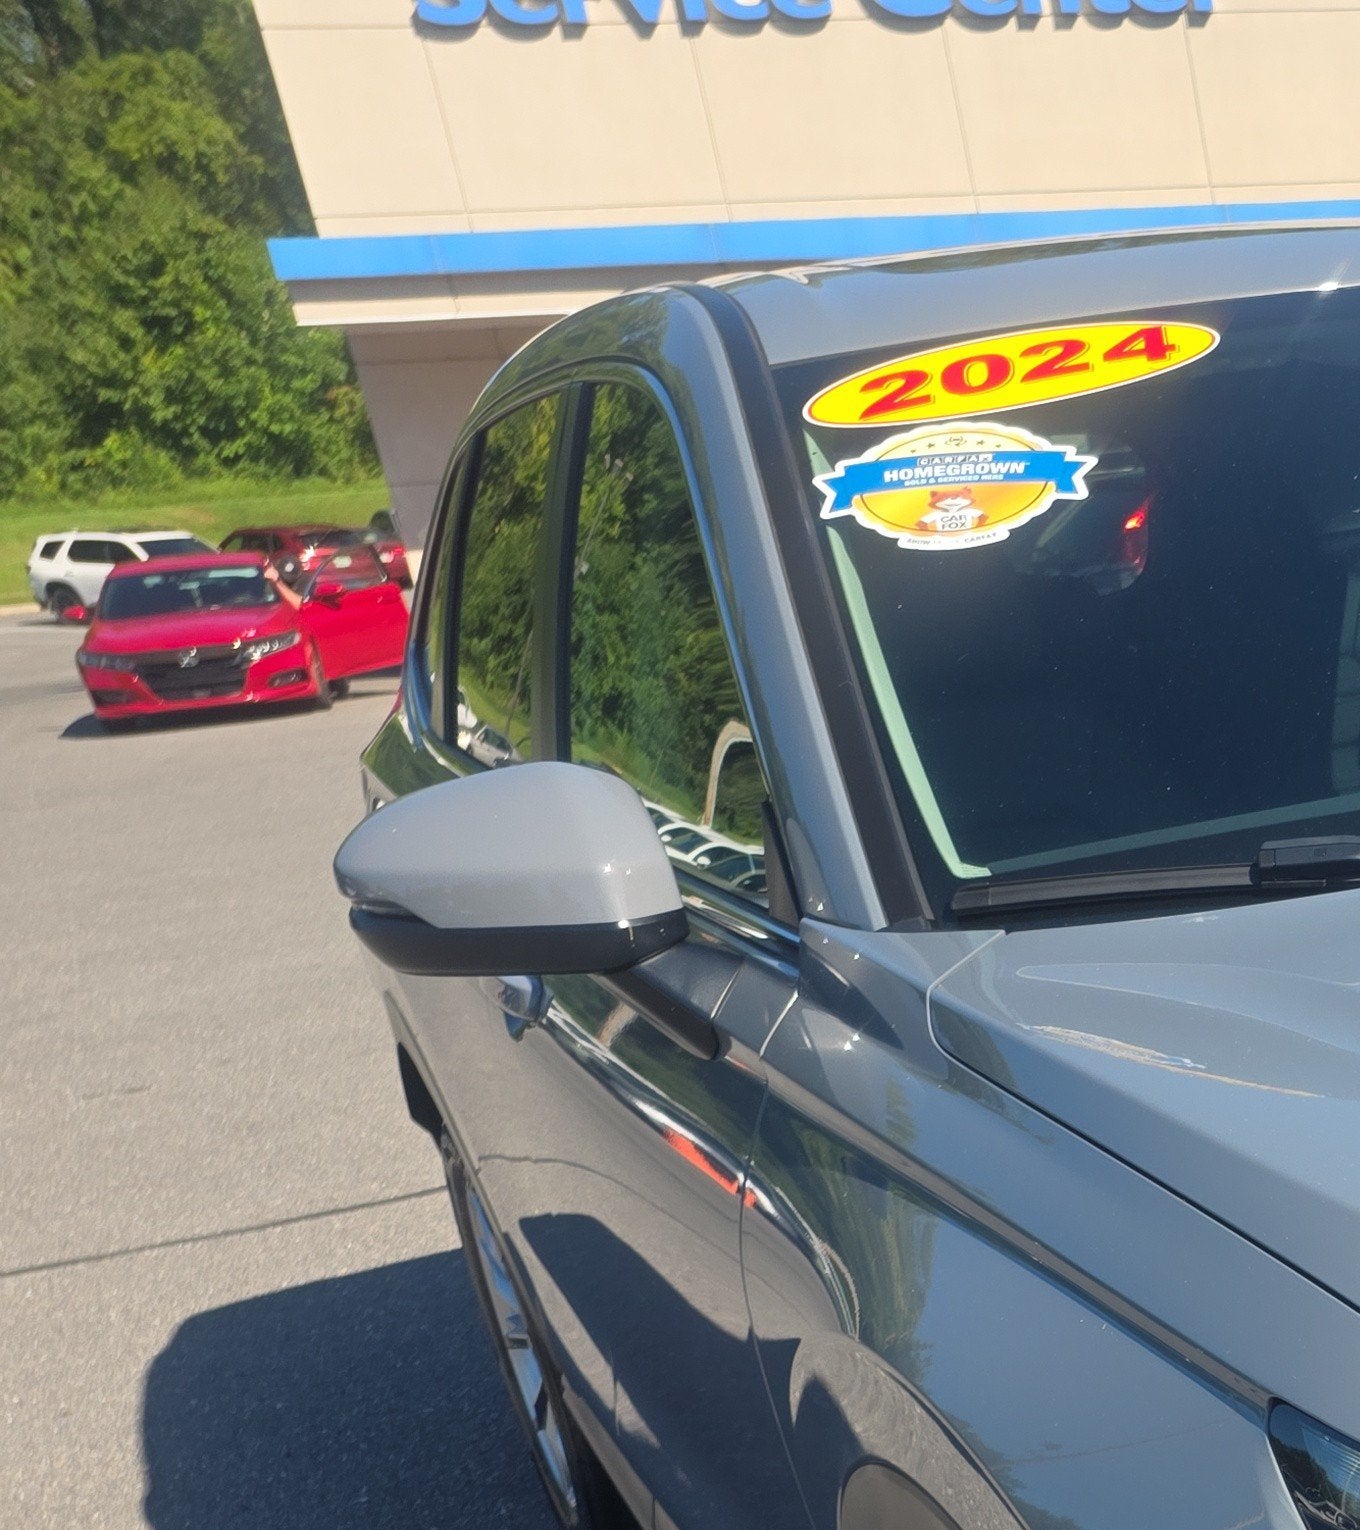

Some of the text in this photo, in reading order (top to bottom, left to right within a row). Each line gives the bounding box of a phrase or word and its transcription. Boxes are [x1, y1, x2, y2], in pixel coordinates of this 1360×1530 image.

[858, 325, 1180, 421] 2024
[917, 453, 994, 466] CARFAX
[883, 461, 1026, 482] HOMEGROWN
[940, 514, 967, 523] CAR
[941, 521, 967, 530] FOX
